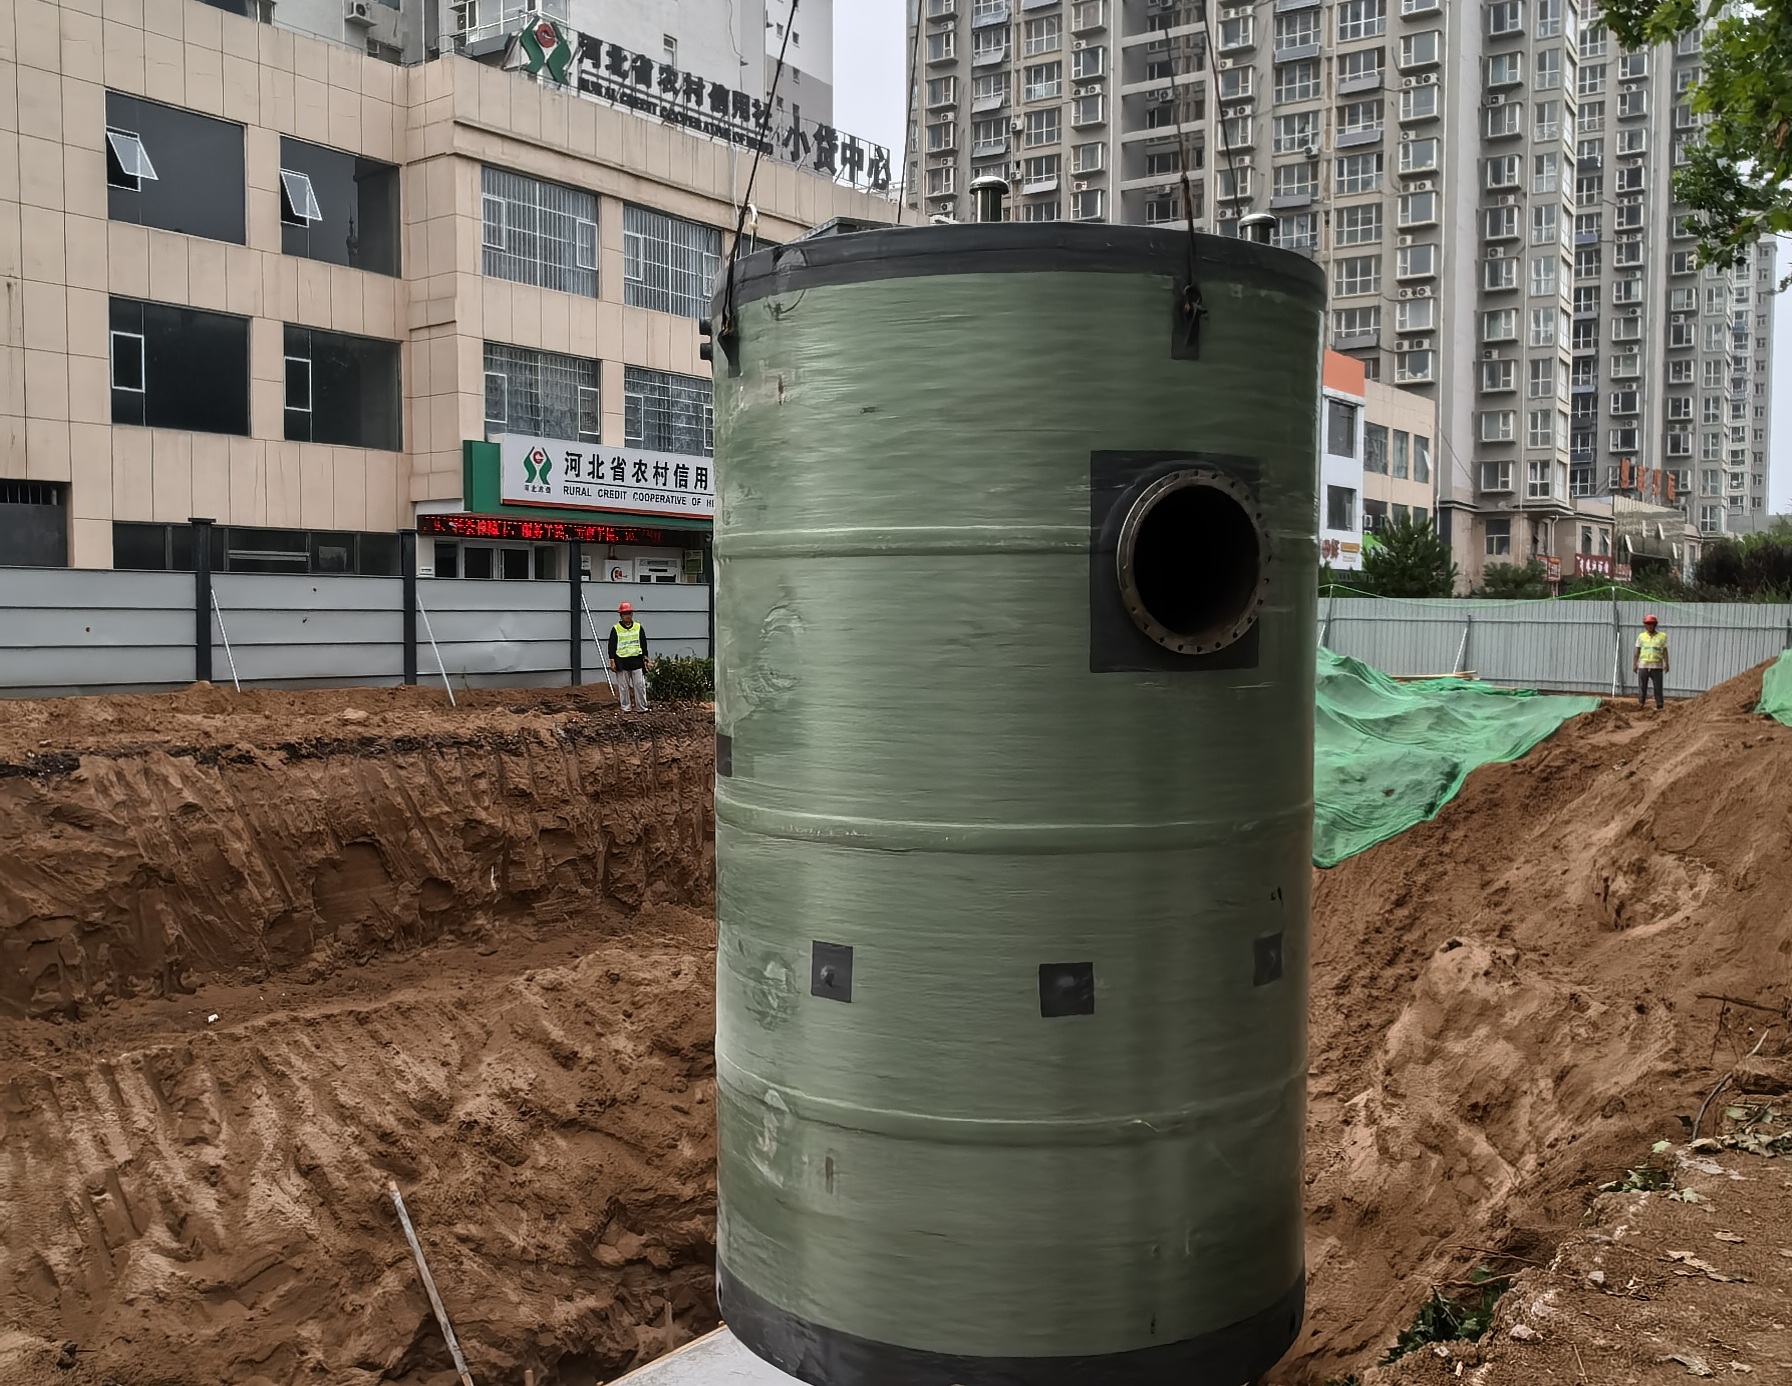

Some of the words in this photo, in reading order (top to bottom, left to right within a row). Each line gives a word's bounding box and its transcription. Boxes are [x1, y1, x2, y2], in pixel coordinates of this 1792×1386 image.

[578, 32, 772, 137] 河北省农村信用社
[782, 102, 892, 191] 小贷中心
[563, 485, 592, 498] RURAL
[597, 488, 628, 501] CREDIT
[632, 492, 687, 507] COOPERATIVE
[691, 497, 702, 507] OF
